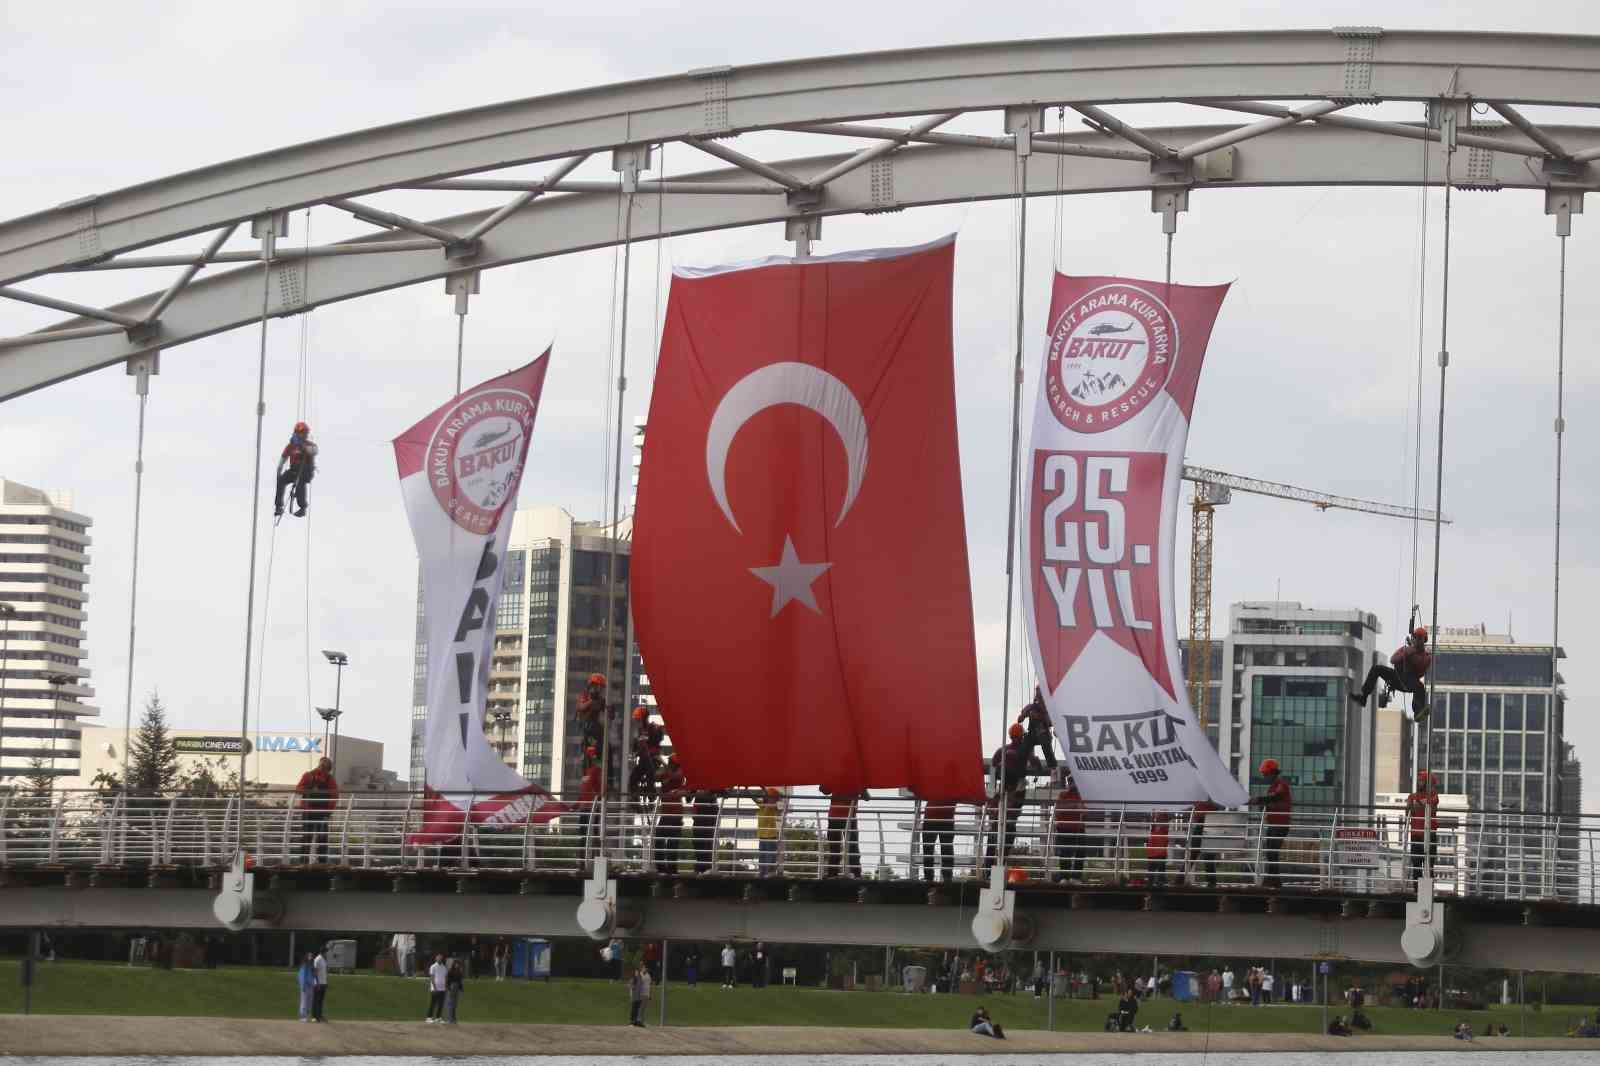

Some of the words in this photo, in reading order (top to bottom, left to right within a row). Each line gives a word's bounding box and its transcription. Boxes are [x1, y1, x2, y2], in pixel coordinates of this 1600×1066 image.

[1050, 312, 1077, 361] BAKUT
[1079, 293, 1128, 316] ARAMA
[1129, 297, 1169, 365] KURTARMA
[1064, 337, 1145, 360] BAKUT
[1086, 413, 1095, 424] &
[1101, 377, 1157, 422] RESCUE
[434, 438, 451, 488] BAKUT
[446, 400, 493, 438] ARAMA
[1043, 454, 1151, 565] 25.
[1041, 565, 1153, 630] YIL
[256, 736, 322, 753] IMAX
[1062, 709, 1186, 755] BAKU
[1073, 755, 1122, 771] ARAMA
[1120, 757, 1134, 770] &
[1128, 768, 1169, 784] 1999
